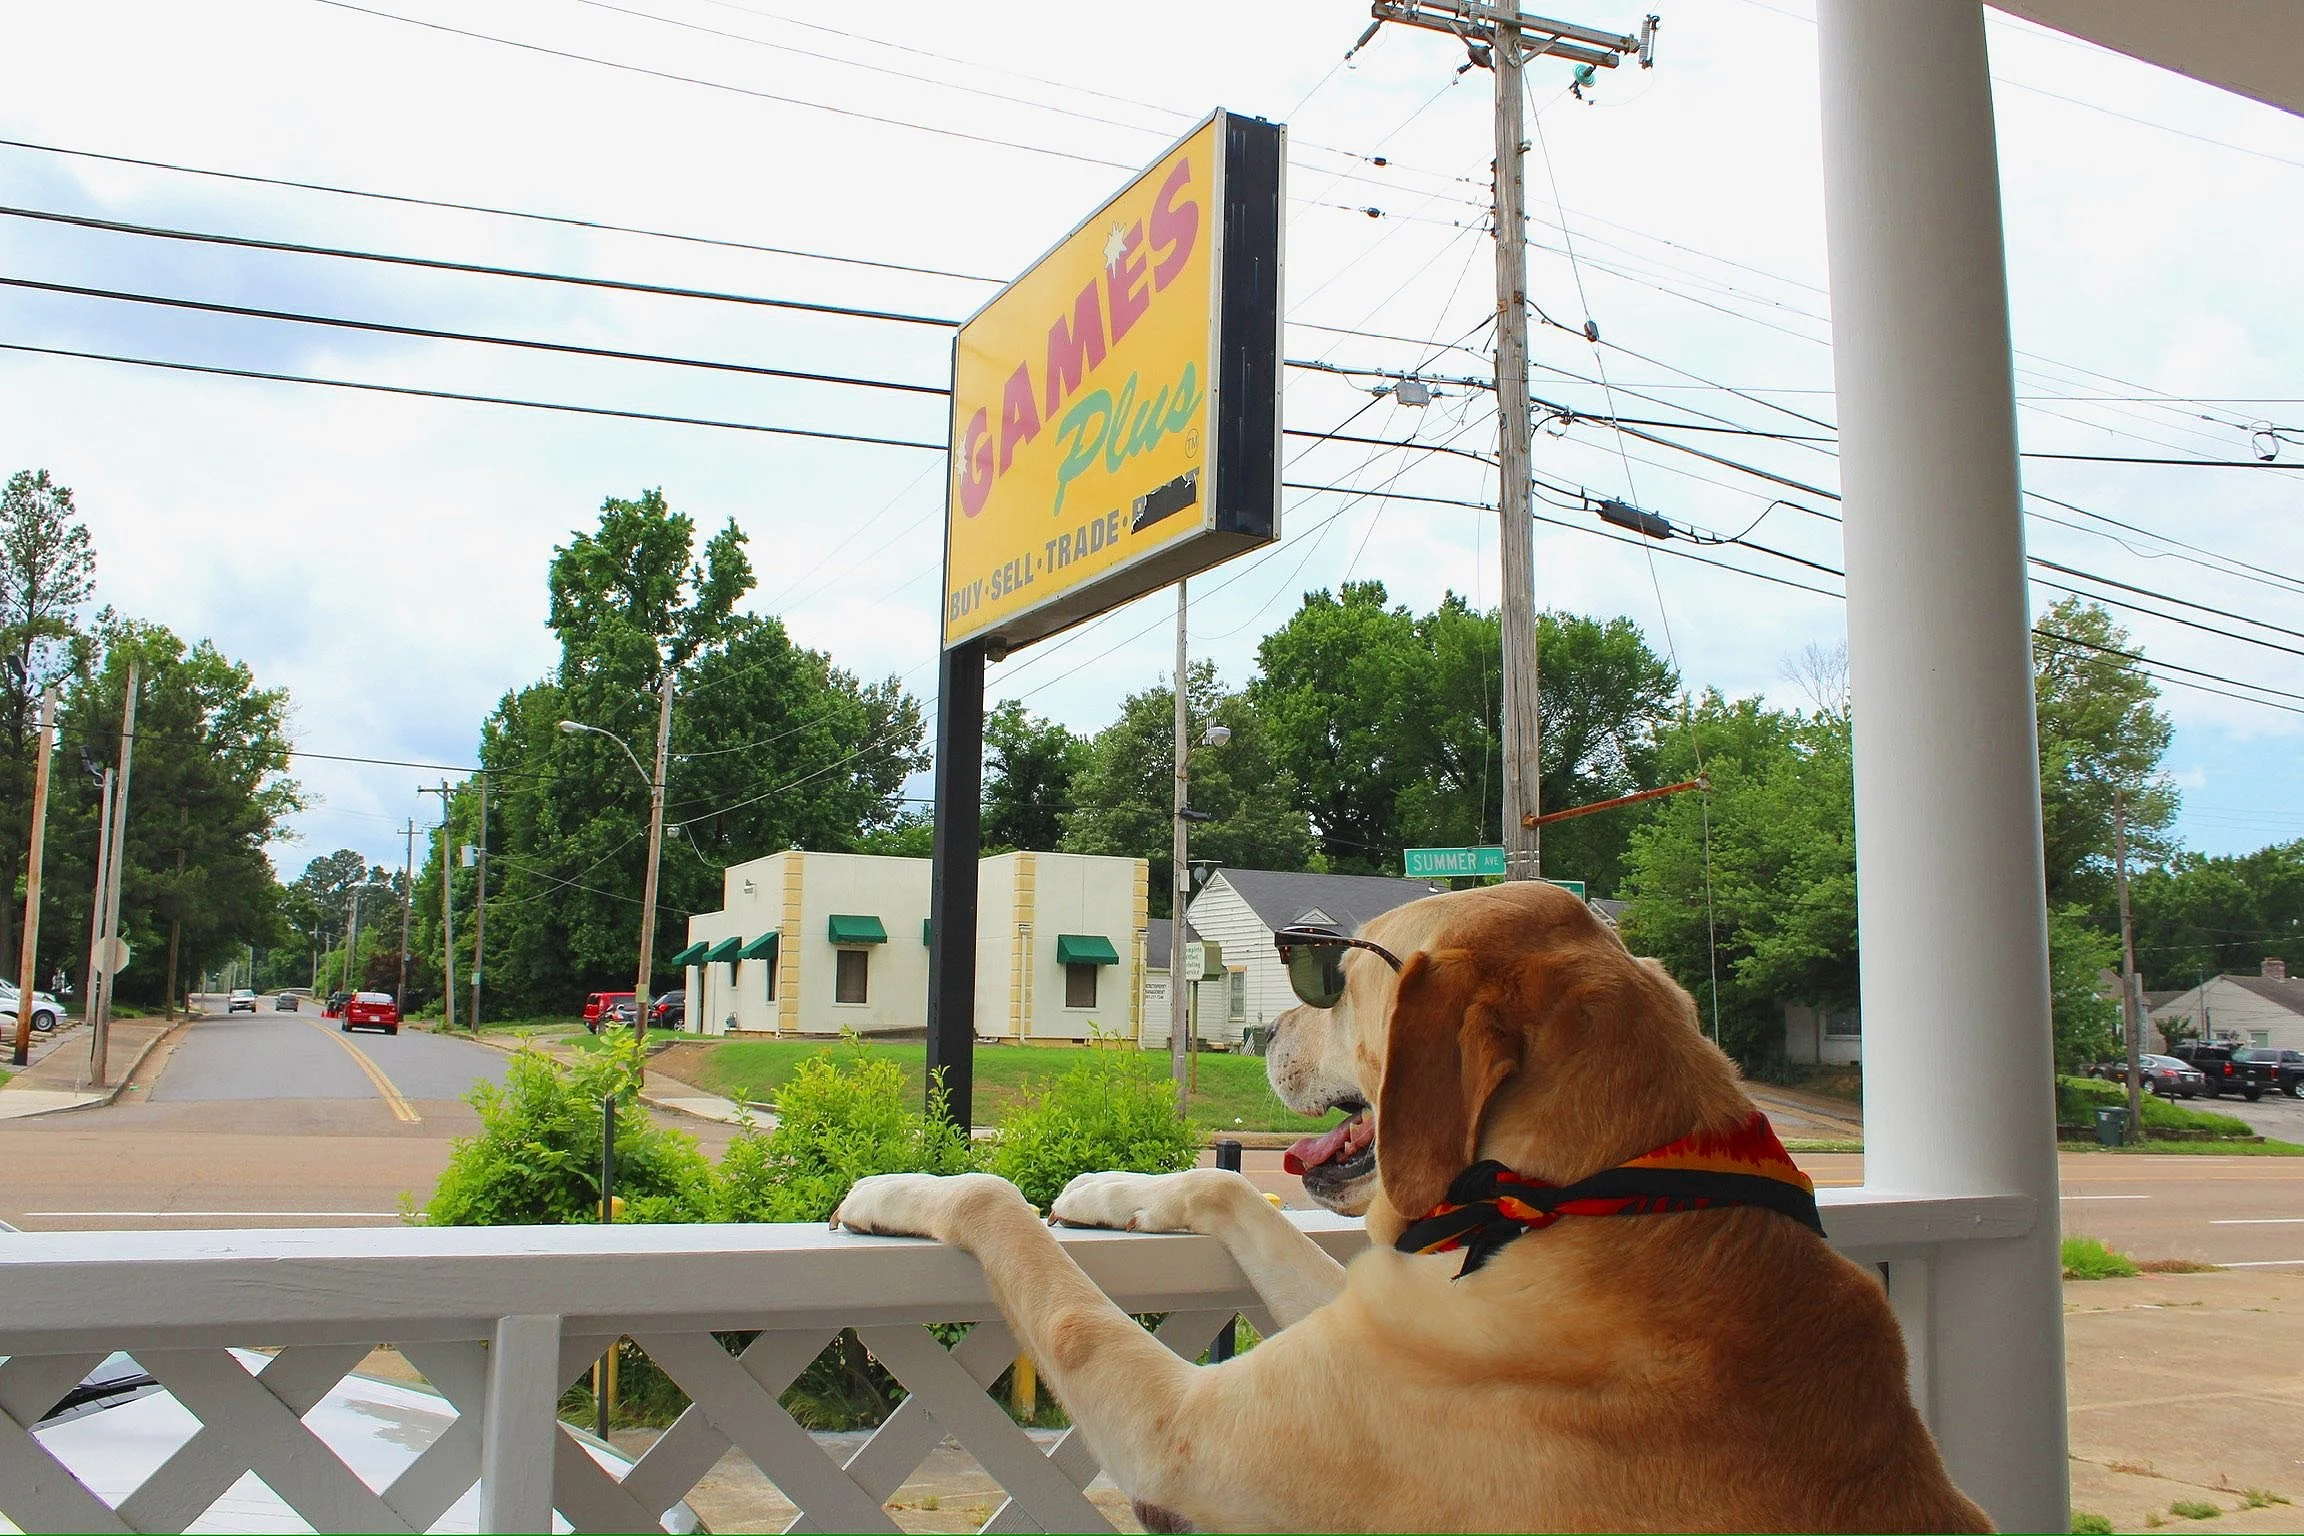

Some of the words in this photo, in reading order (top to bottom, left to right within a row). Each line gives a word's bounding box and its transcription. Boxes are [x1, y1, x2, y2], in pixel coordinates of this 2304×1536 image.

[959, 156, 1200, 518] GAMES
[1053, 361, 1204, 517] Plus
[950, 578, 983, 622] BUY
[991, 552, 1034, 601] SELL
[1045, 509, 1119, 574] TRADE
[1413, 853, 1477, 871] SUMMER
[1484, 855, 1499, 866] AVE
